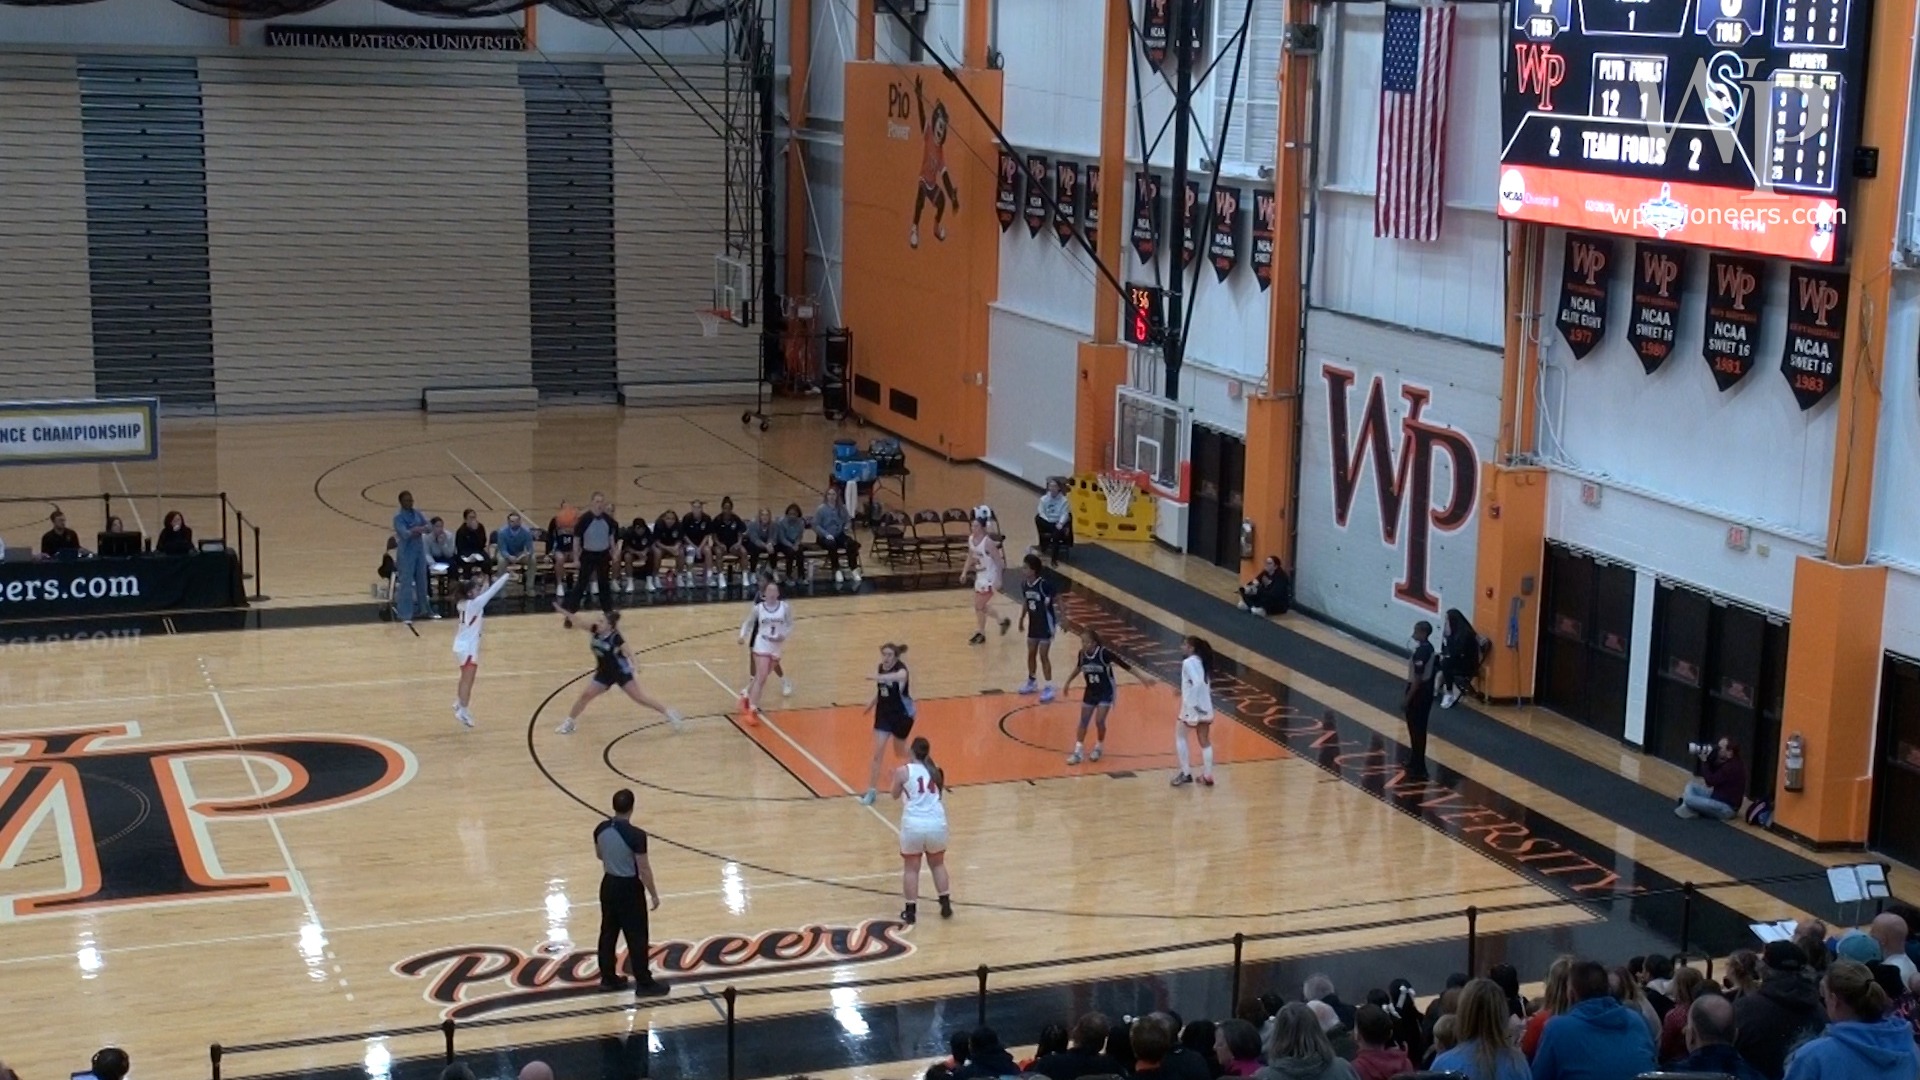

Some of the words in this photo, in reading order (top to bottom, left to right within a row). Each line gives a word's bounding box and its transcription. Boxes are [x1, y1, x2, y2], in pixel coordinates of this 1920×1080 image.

[270, 31, 344, 48] WILLIAM
[350, 32, 431, 49] PATERSON
[432, 33, 526, 50] UNIVERSITY
[889, 82, 910, 119] Pio
[1602, 89, 1621, 117] 12
[1549, 125, 1561, 157] 2
[1582, 131, 1620, 161] TEAM
[1622, 135, 1668, 167] FOULS
[1688, 137, 1703, 171] 2
[1572, 240, 1606, 285] WP
[1643, 251, 1678, 297] WP
[1717, 263, 1756, 310] WP
[1570, 296, 1596, 313] NCAA
[1798, 277, 1839, 326] WP
[1641, 308, 1671, 326] NCAA
[1714, 321, 1747, 341] NCAA
[1708, 338, 1736, 354] SWEET
[1738, 343, 1751, 357] 16
[1795, 337, 1830, 359] NCAA
[1790, 353, 1819, 372] SWEET
[33, 422, 142, 441] CHAMPIONSHIP
[1320, 358, 1482, 618] WP
[916, 775, 937, 794] 14
[390, 917, 919, 1021] Pioneers
